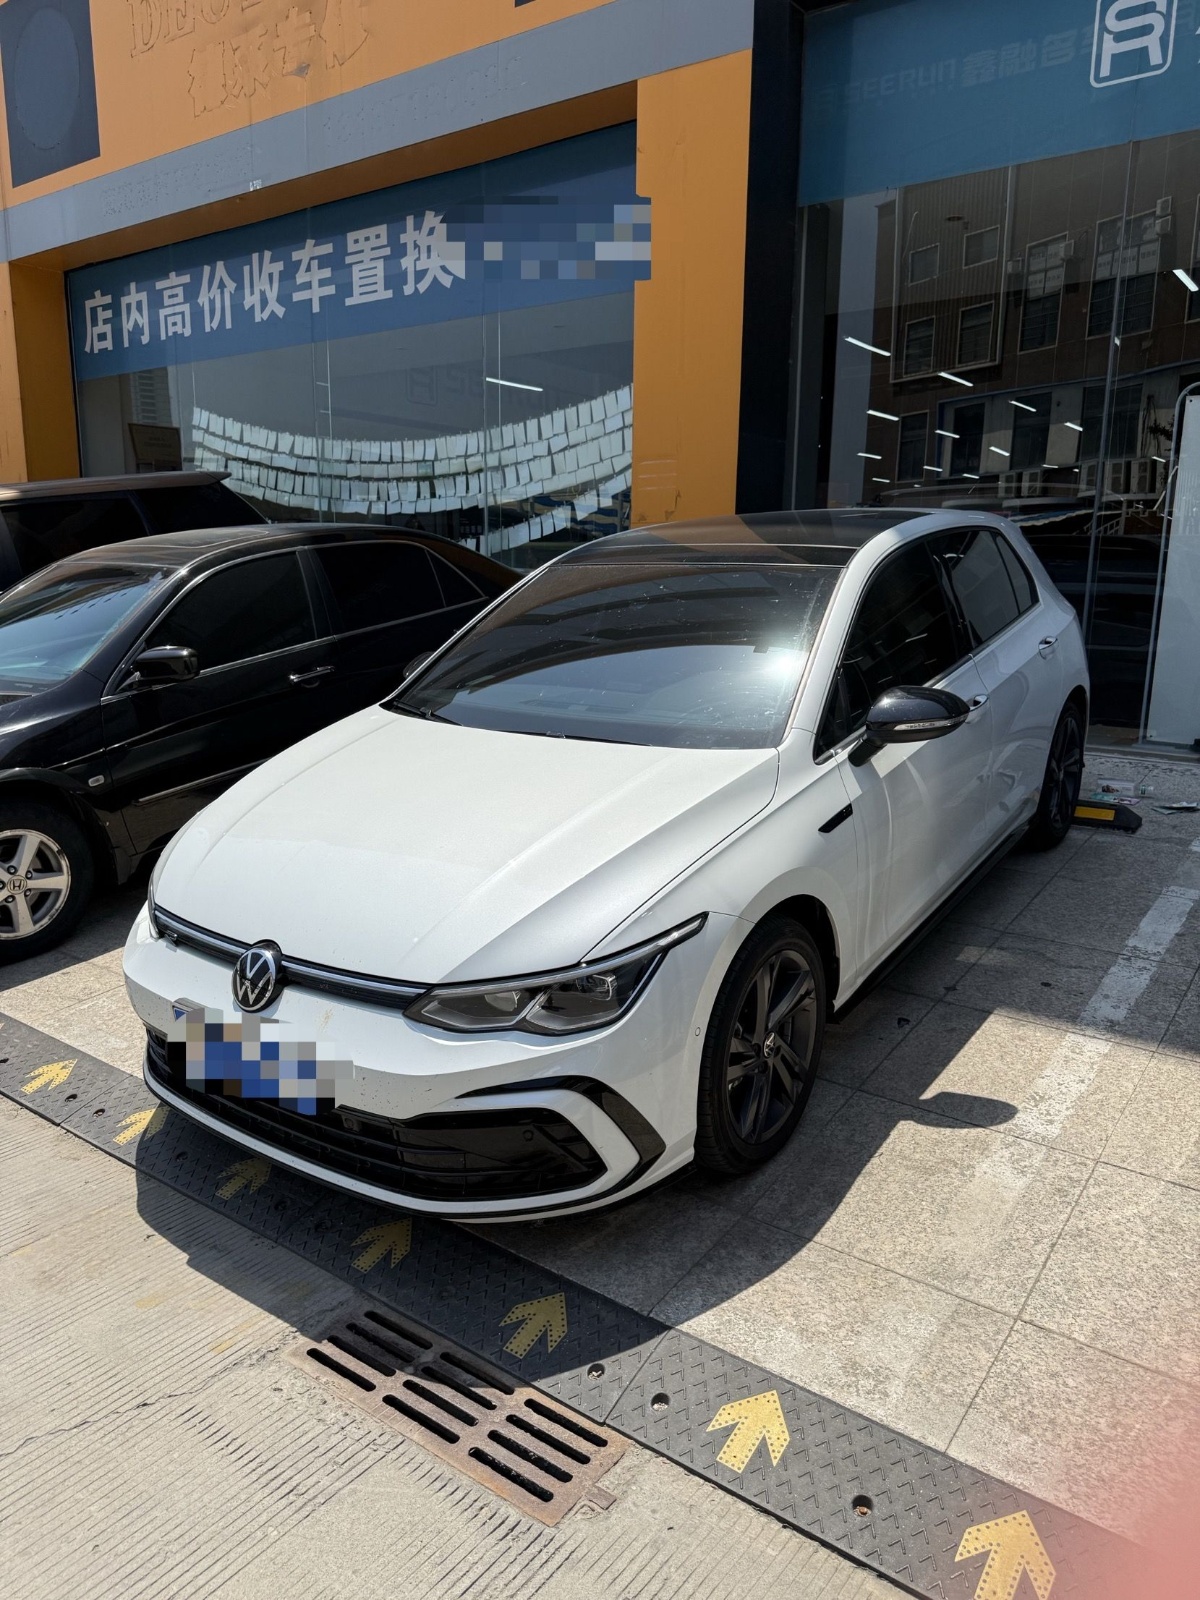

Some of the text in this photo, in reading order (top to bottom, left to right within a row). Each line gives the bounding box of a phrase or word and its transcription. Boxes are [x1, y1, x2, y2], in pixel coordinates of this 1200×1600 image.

[84, 210, 455, 354] 店内高价收车置换
